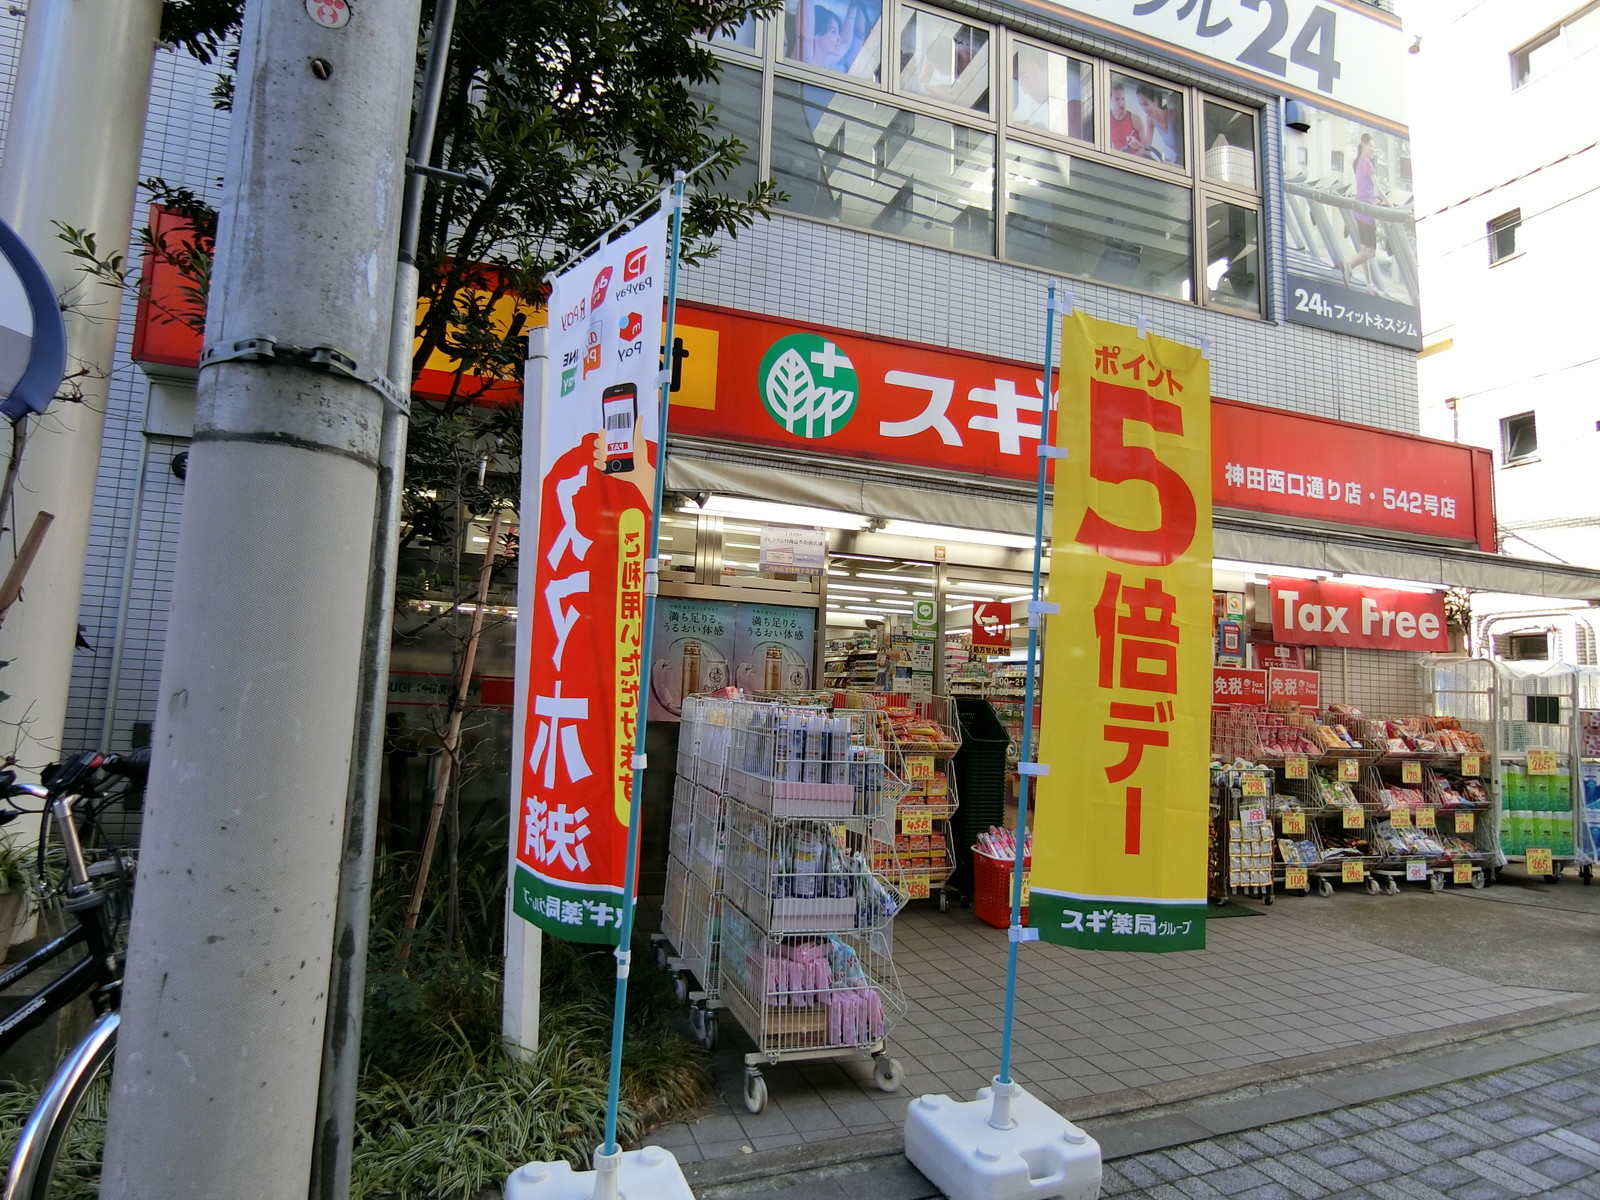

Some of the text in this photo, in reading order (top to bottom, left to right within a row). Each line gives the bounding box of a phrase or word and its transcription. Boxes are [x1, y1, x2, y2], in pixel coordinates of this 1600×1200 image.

[1294, 288, 1418, 338] 24h フィットネスジム
[1094, 345, 1184, 396] ポイント
[1224, 462, 1456, 520] 神田西口通り店・542号店
[1075, 376, 1197, 856] 5倍デー
[1277, 589, 1440, 639] Tax Free
[664, 622, 724, 636] うるおい体感
[747, 627, 805, 641] うるおい体感
[973, 645, 1010, 656] 処方せん受付
[388, 681, 411, 693] UGI
[1214, 676, 1243, 695] 免税
[1271, 677, 1298, 696] 免税
[911, 765, 929, 776] 178
[907, 820, 929, 829] 458
[1061, 909, 1192, 937] スギ薬局グループ
